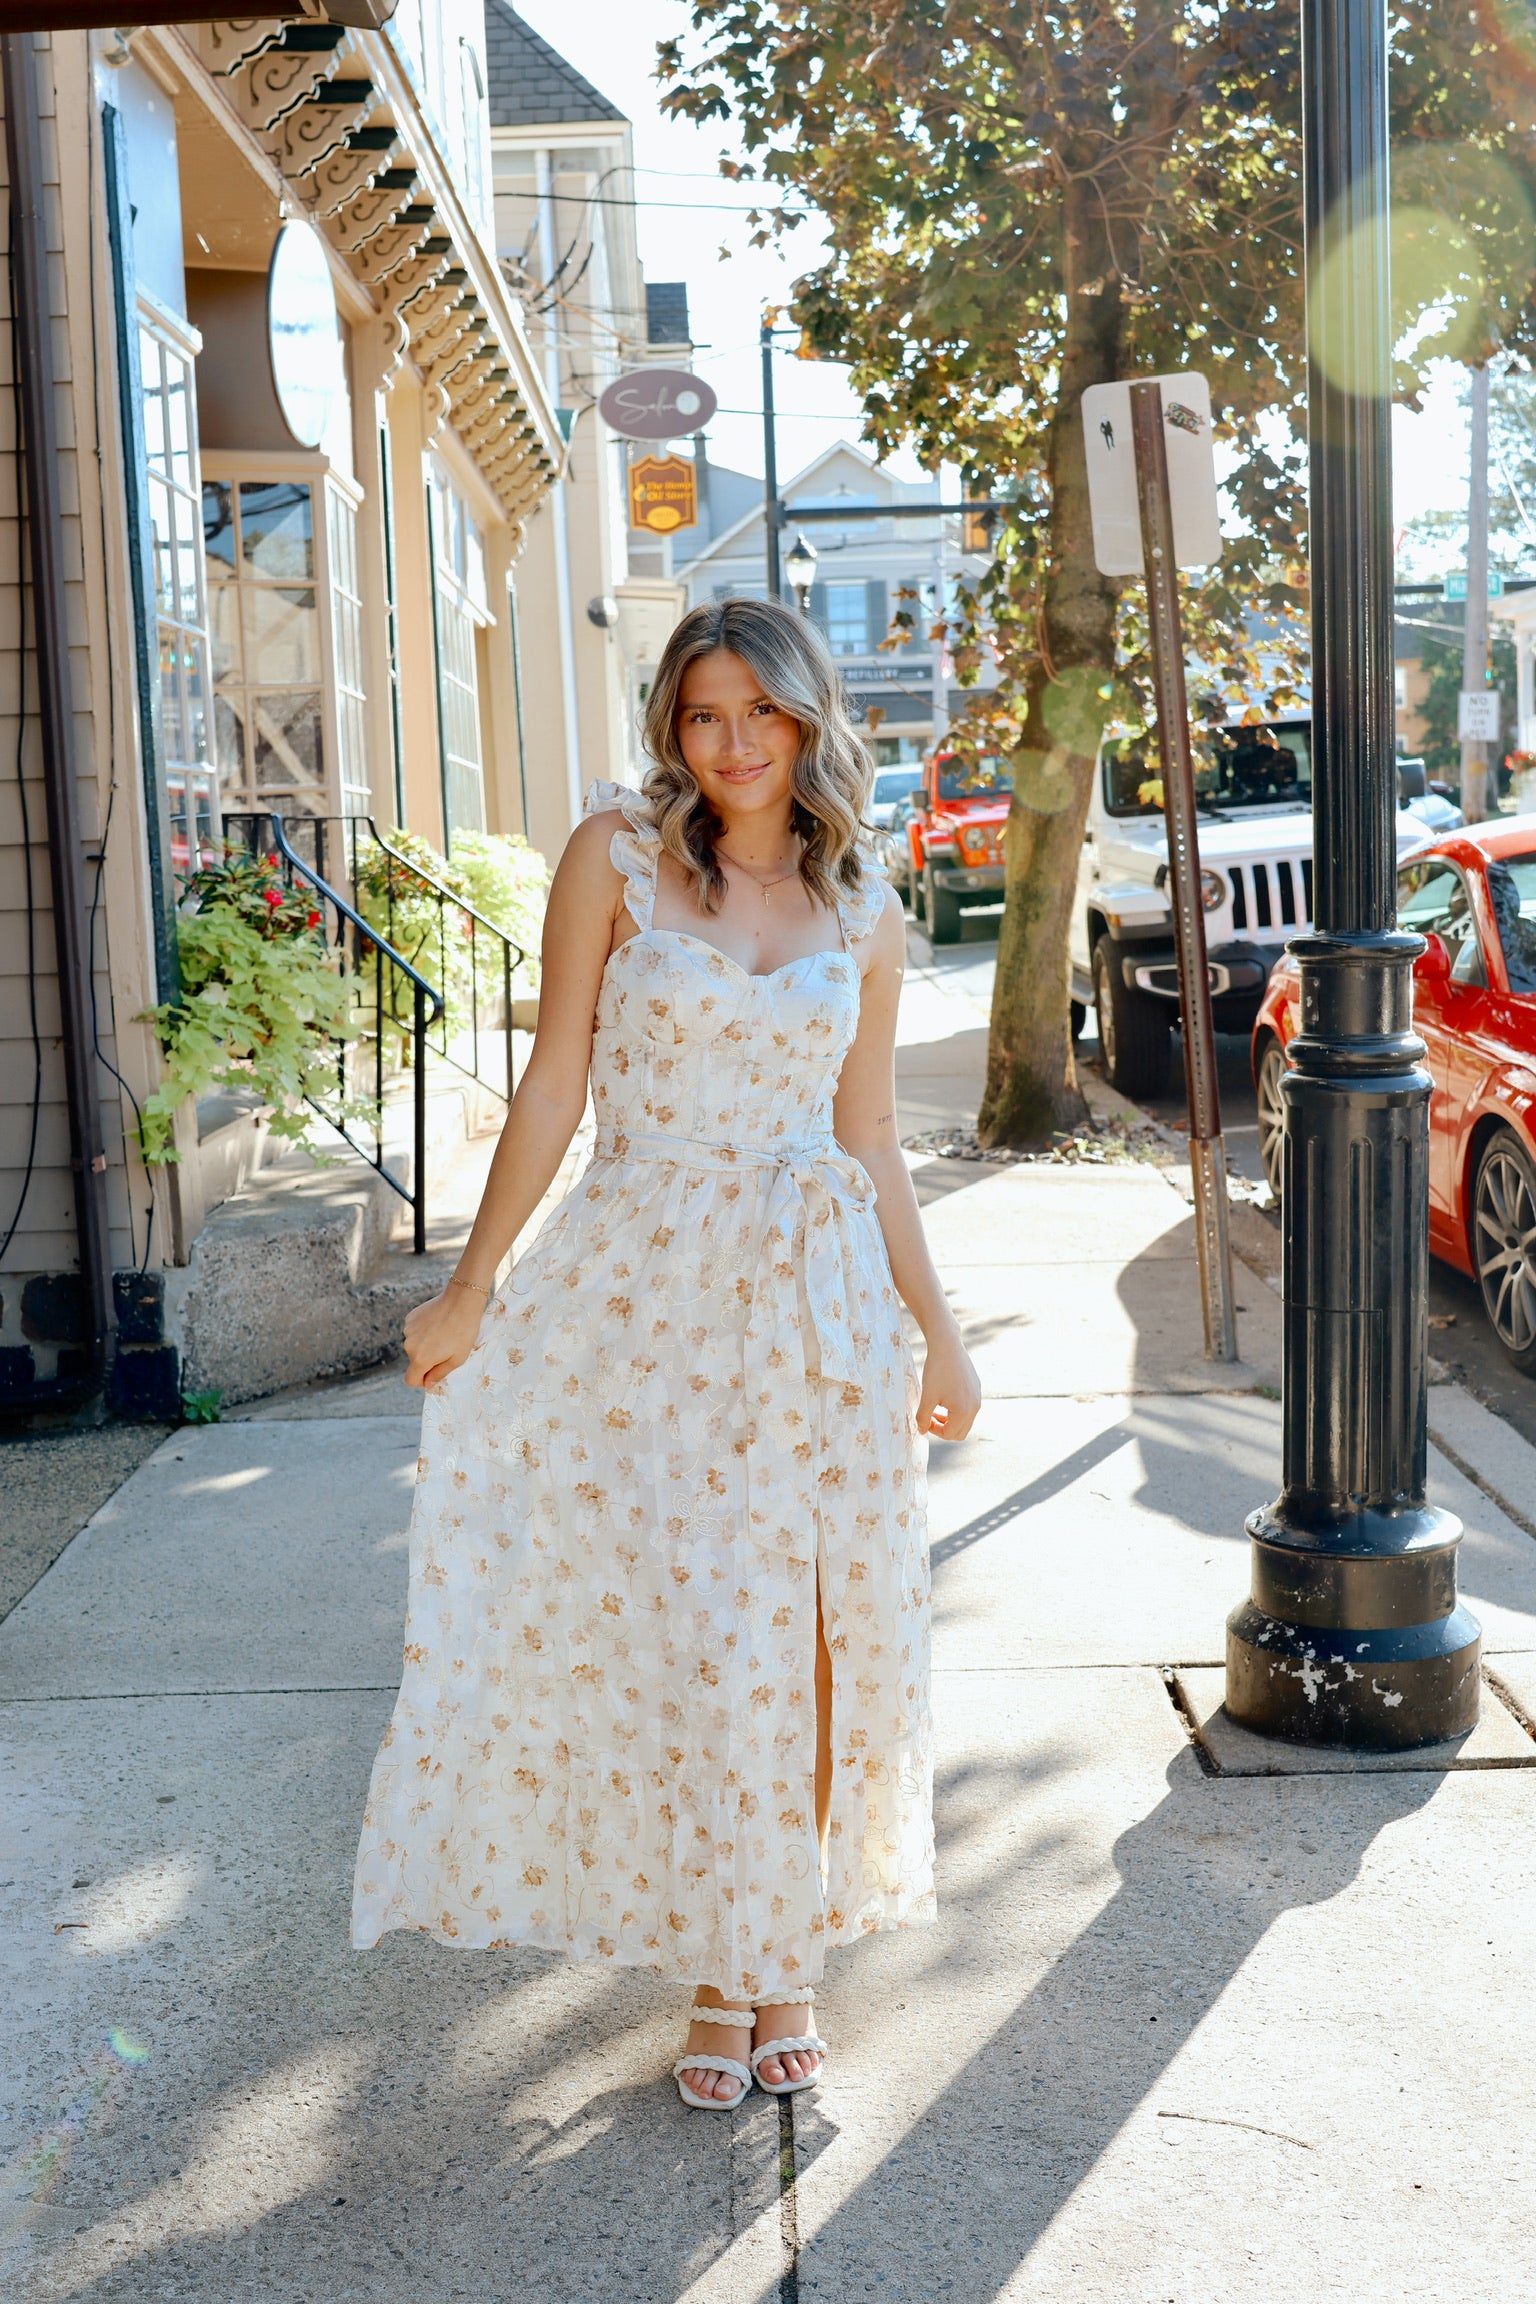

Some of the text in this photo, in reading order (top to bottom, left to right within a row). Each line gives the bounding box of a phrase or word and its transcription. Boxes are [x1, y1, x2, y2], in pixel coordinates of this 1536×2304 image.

[1469, 696, 1488, 705] NO
[1468, 707, 1490, 716] TURN
[1471, 718, 1485, 726] ON
